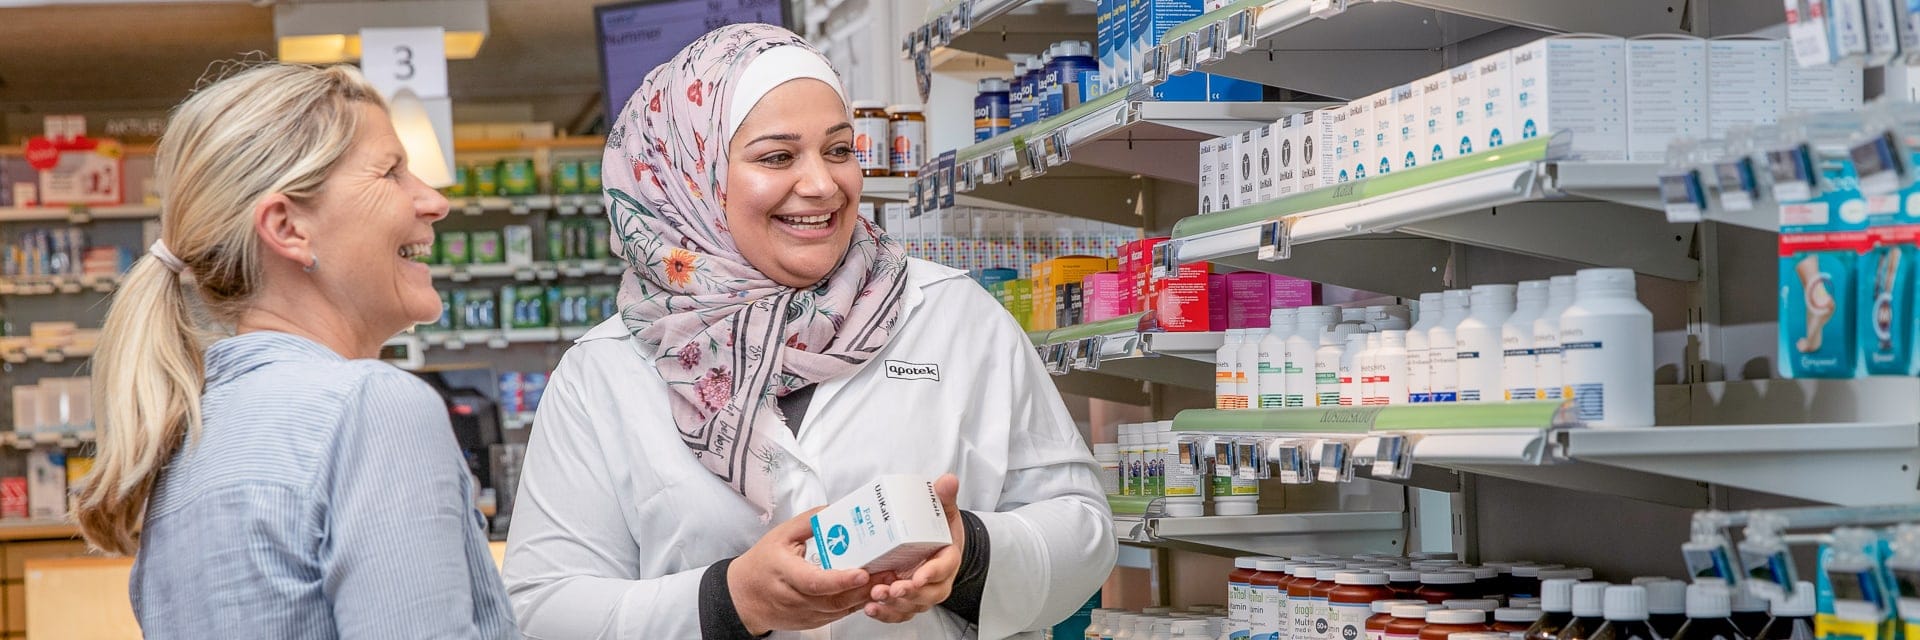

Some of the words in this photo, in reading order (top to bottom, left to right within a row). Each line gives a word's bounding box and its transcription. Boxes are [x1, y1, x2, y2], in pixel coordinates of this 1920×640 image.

[393, 45, 414, 80] 3
[889, 365, 937, 376] apotek
[875, 483, 891, 523] UniKalk
[926, 481, 941, 518] UniKalk
[863, 507, 876, 536] Forte
[1316, 622, 1327, 630] 50+
[1344, 628, 1357, 637] 50+
